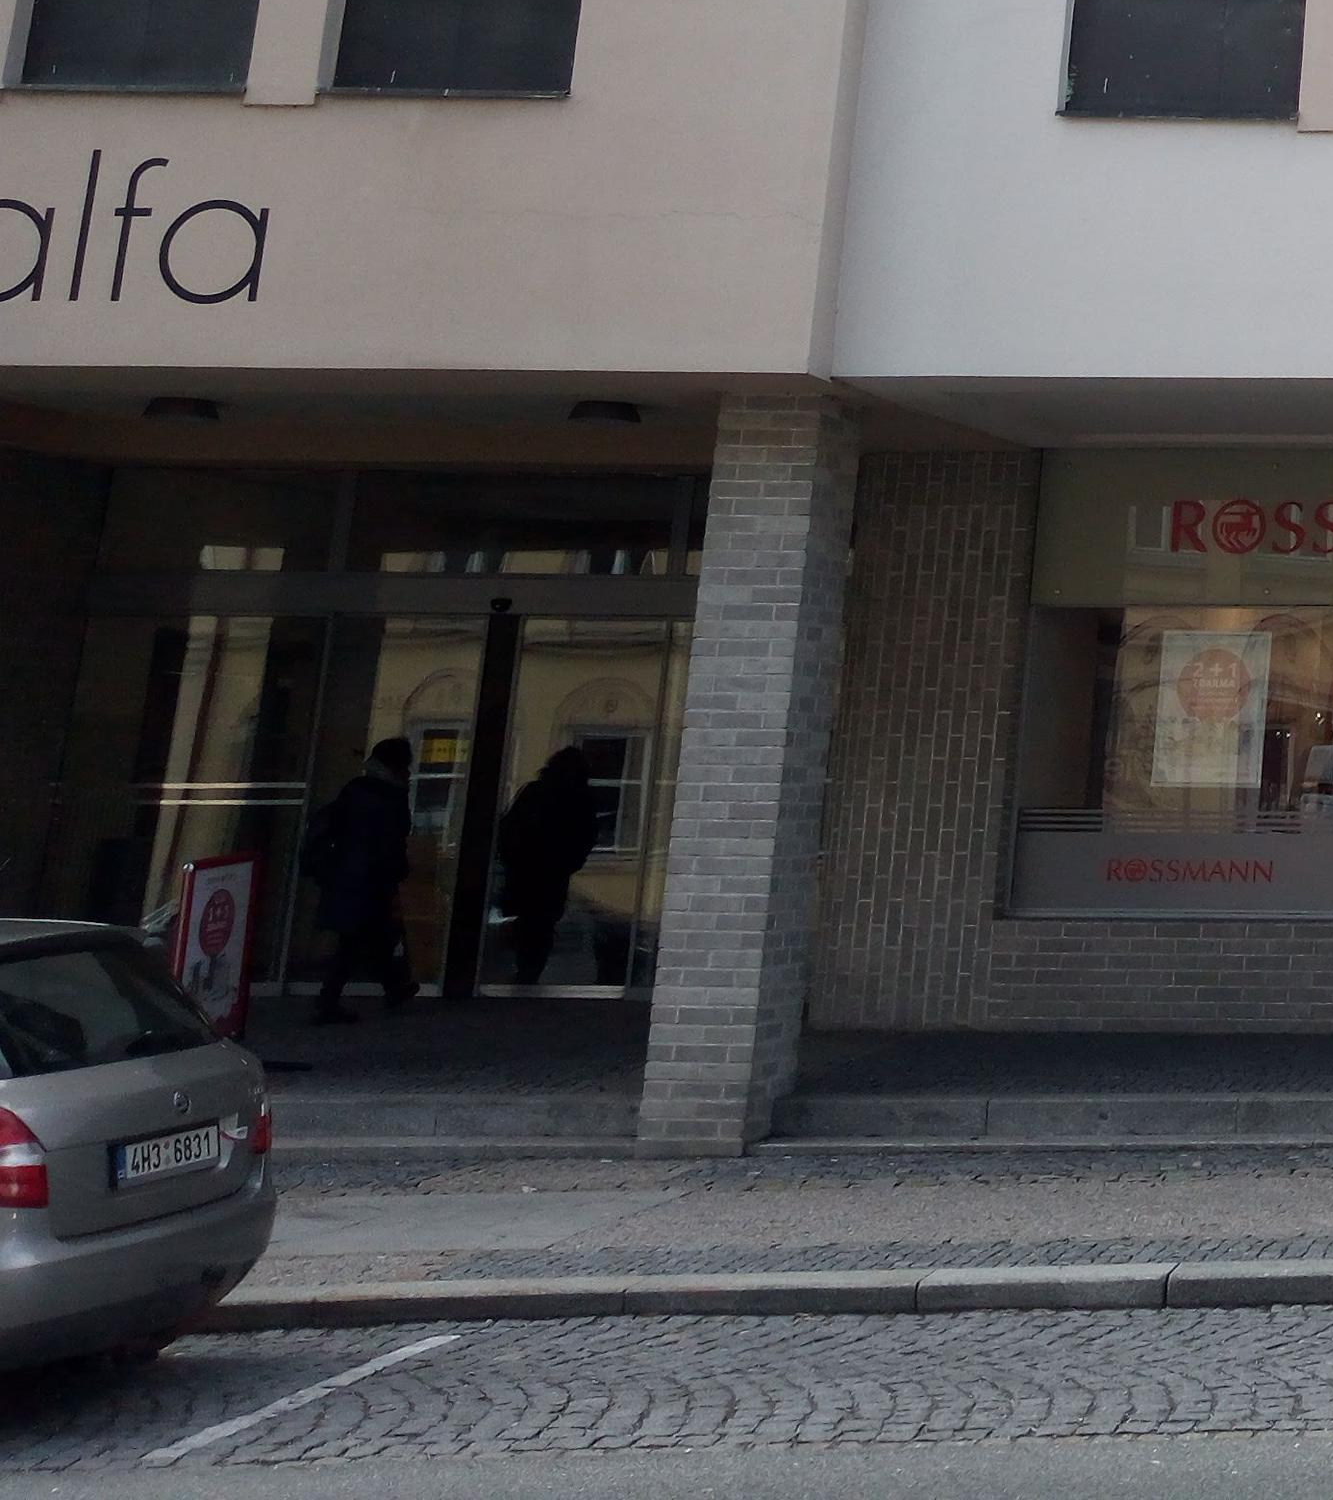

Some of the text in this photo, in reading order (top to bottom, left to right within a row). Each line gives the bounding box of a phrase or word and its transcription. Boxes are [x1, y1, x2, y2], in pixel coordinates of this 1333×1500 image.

[1106, 858, 1273, 883] ROSSMANN
[131, 1131, 212, 1174] 4H3 6831
